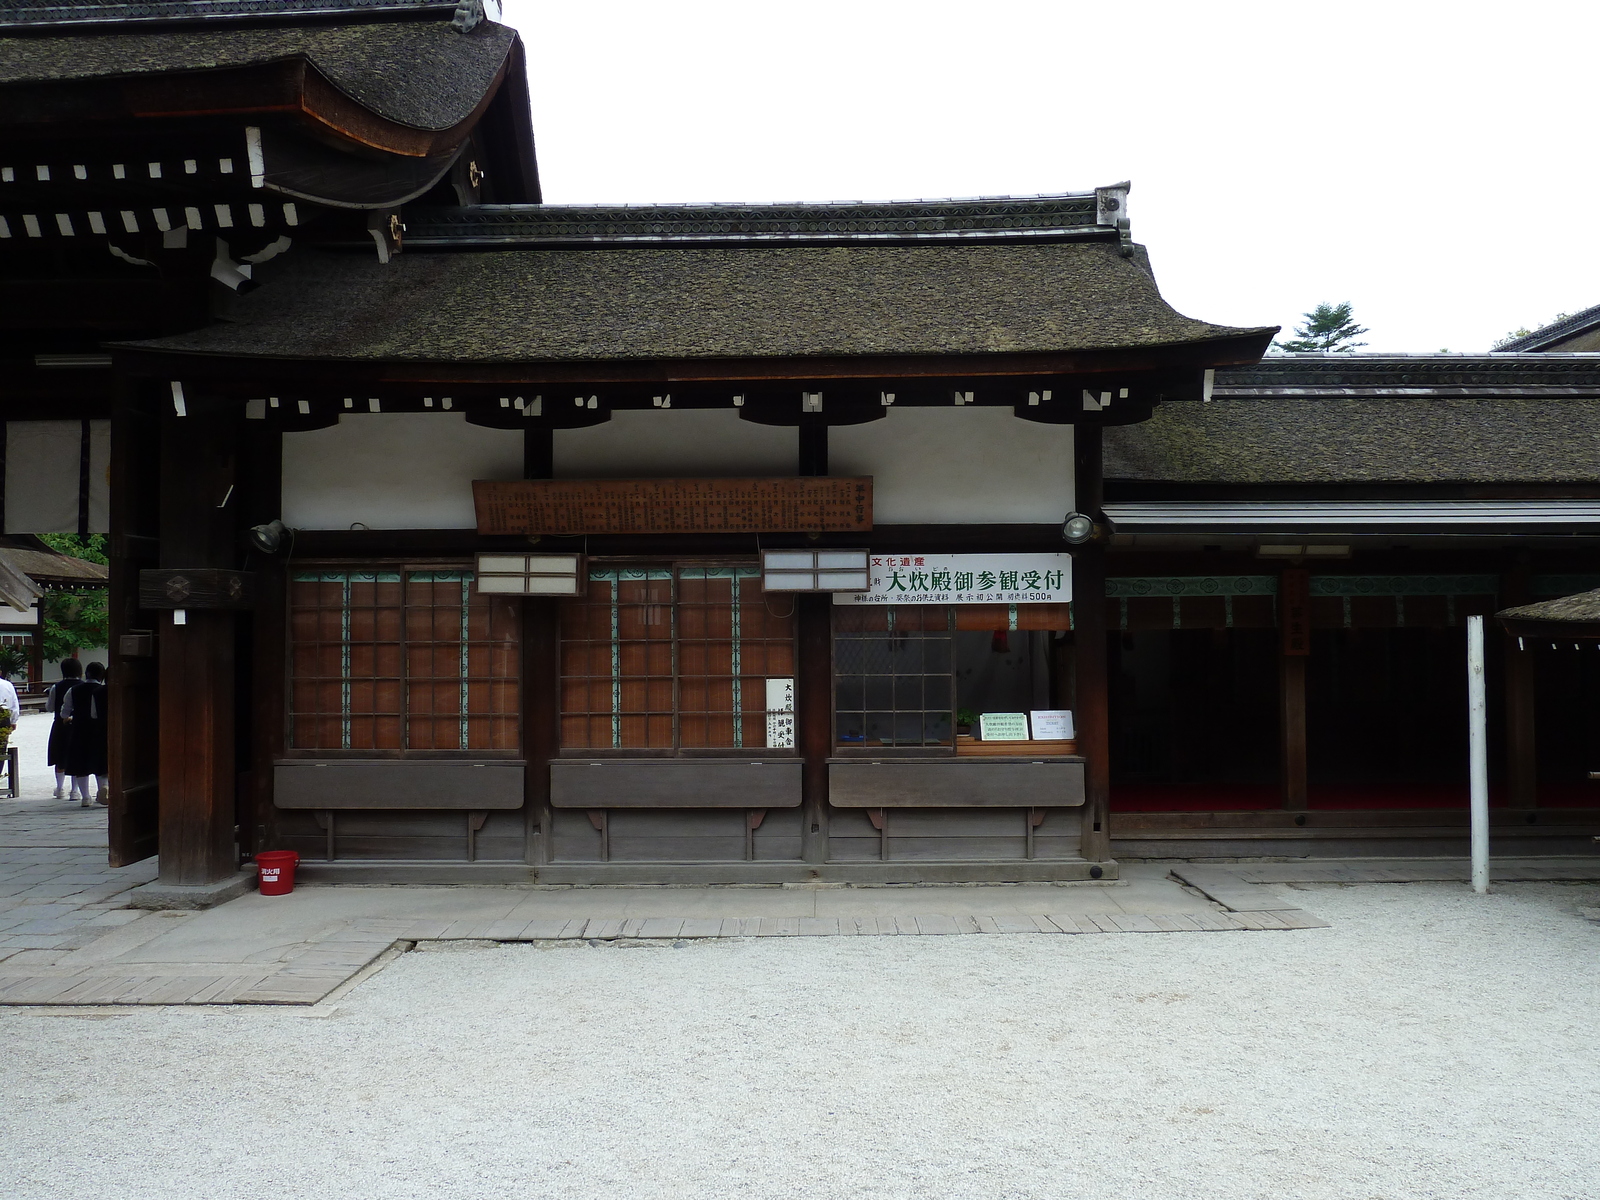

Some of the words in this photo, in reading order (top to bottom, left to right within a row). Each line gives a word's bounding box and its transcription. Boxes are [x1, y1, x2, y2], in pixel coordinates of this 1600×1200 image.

[871, 557, 925, 567] 文化遺産
[885, 569, 1064, 592] 大炊殿御参観受付
[956, 593, 1003, 601] 展示初公開
